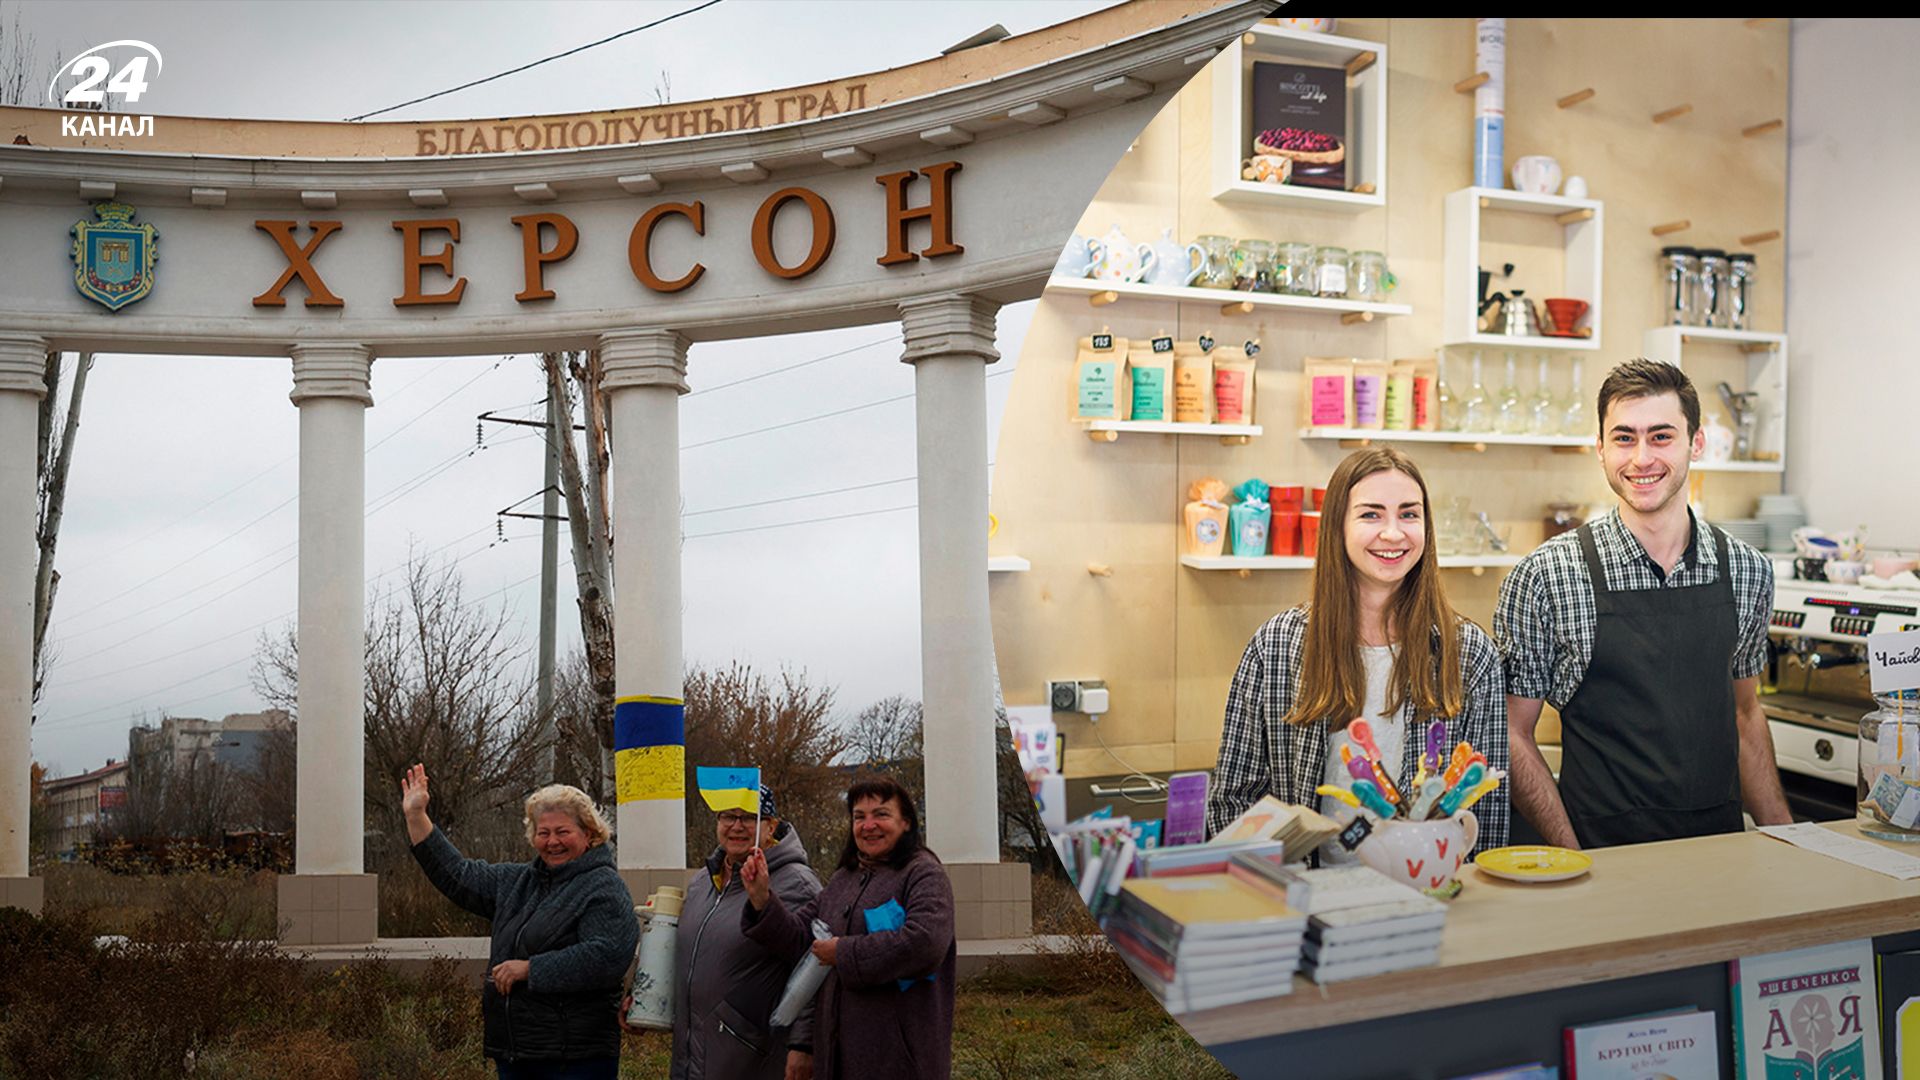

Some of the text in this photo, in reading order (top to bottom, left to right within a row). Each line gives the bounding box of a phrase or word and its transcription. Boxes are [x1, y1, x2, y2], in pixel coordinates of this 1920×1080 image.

[415, 83, 868, 156] БЛАГОПОЛУЧНЫЙ ГРАД
[252, 161, 965, 308] ХЕРСОН
[1344, 821, 1366, 845] 95
[1768, 970, 1850, 994] ШЕВЧЕНКО
[1598, 1037, 1695, 1061] КРУГОМ СВІТУ
